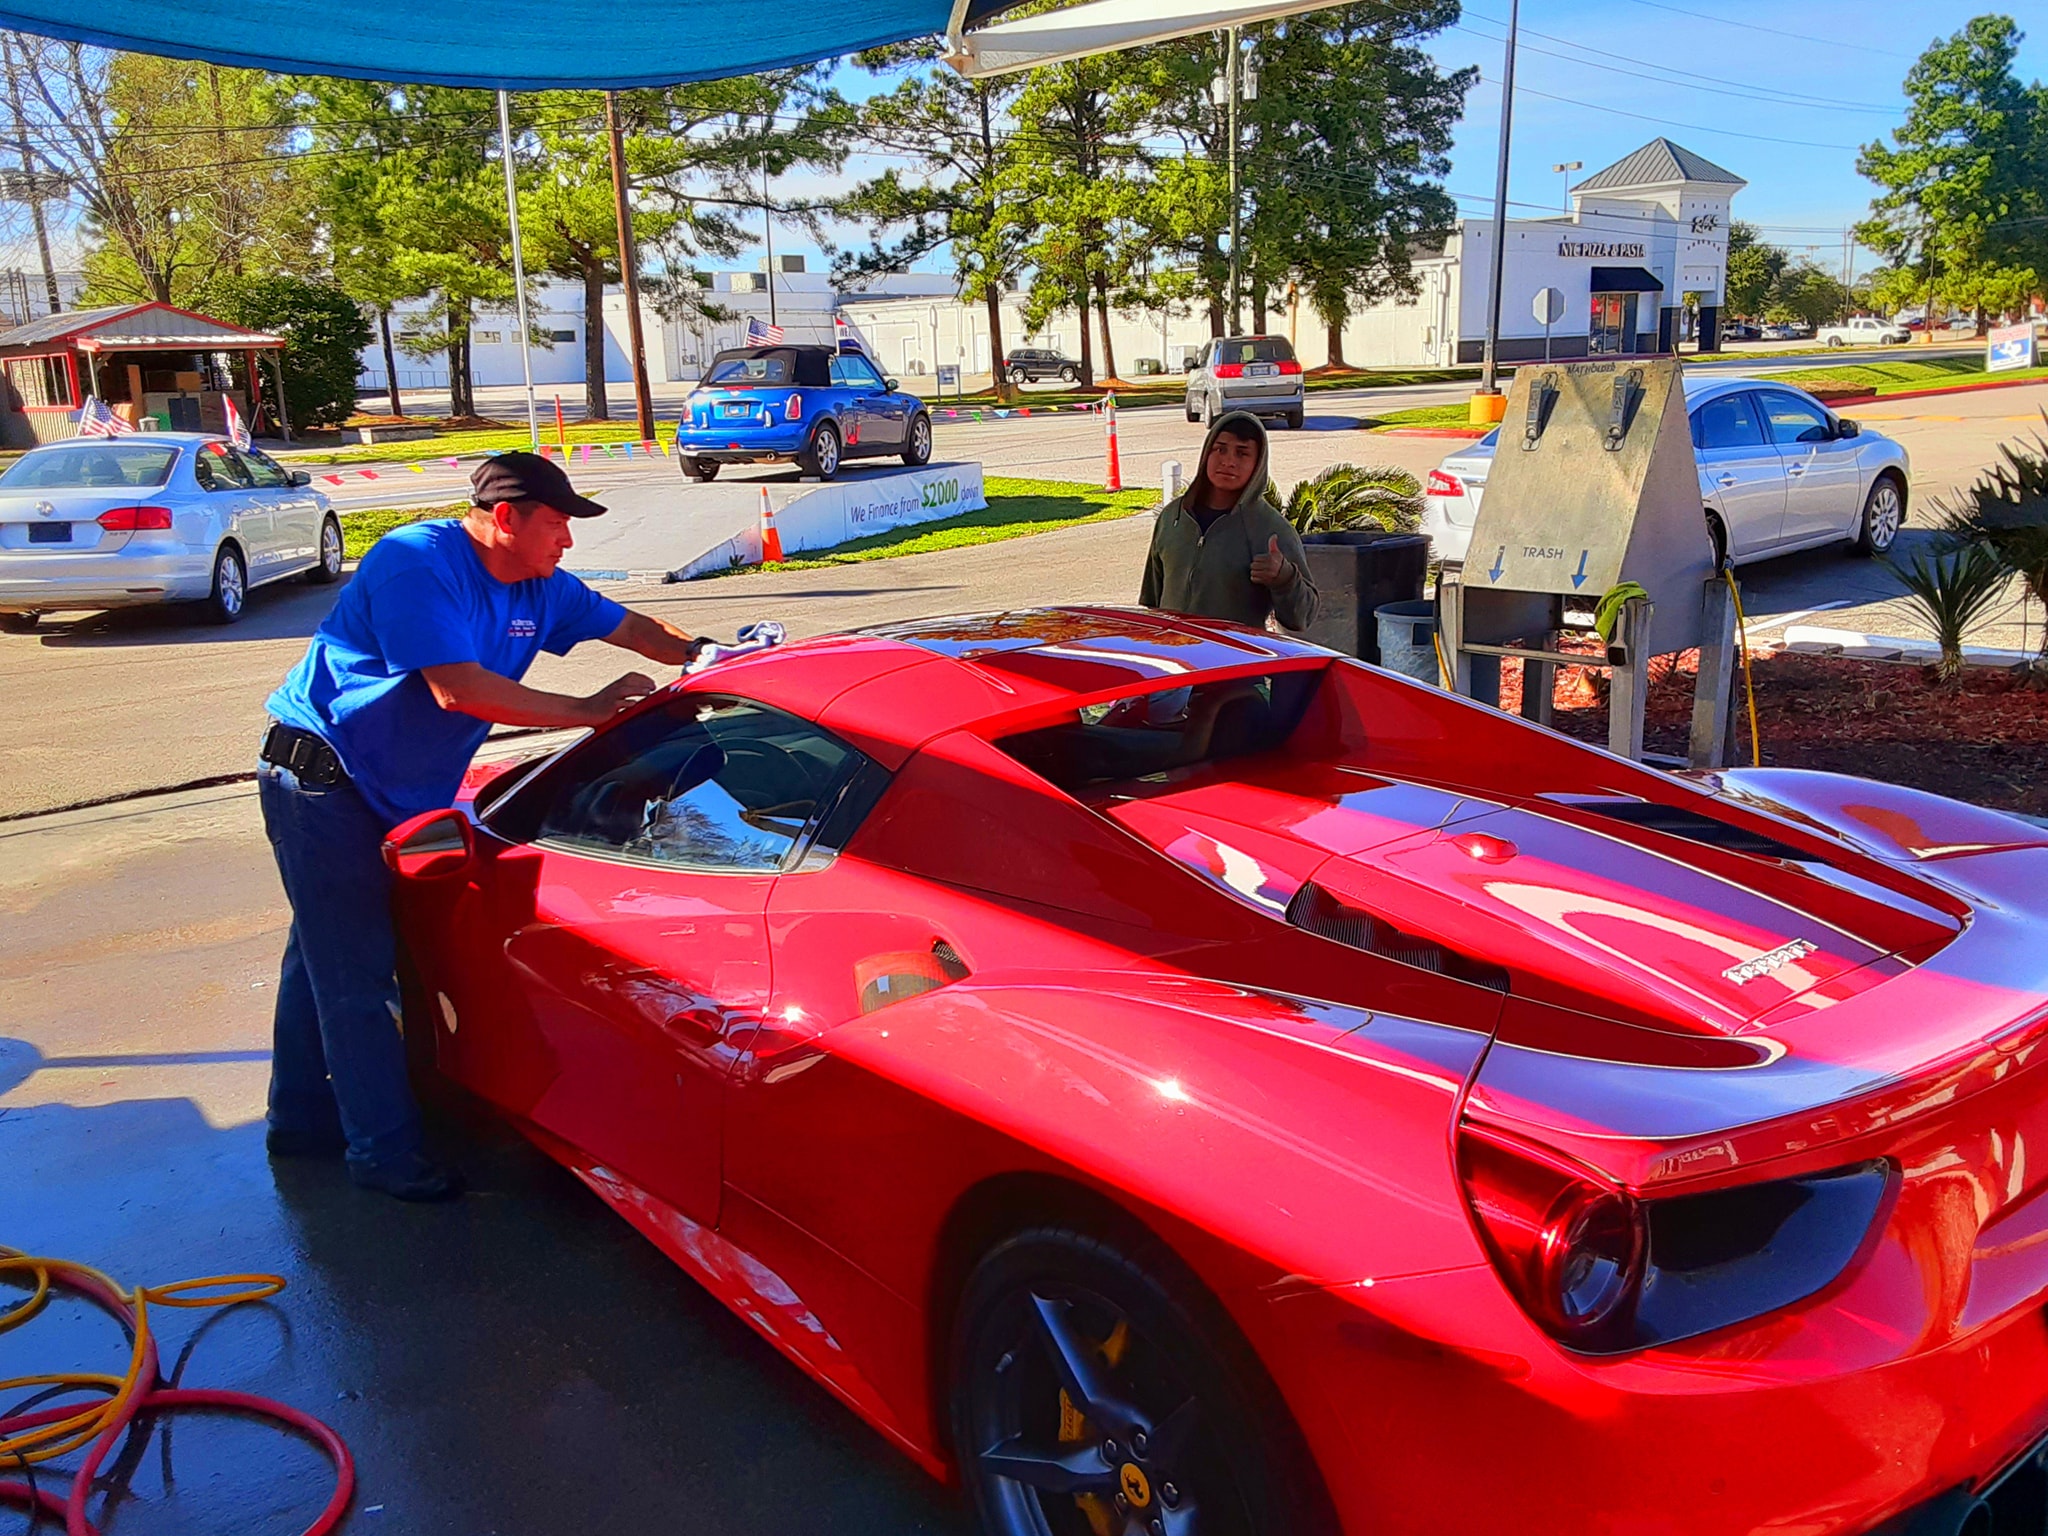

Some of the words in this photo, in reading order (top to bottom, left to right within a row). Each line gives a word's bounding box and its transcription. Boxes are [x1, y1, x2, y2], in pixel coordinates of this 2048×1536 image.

[1559, 243, 1581, 257] NYC
[1582, 243, 1608, 257] PIZZA
[1610, 244, 1618, 257] &
[1619, 244, 1646, 257] PASTA
[851, 506, 865, 523] We
[868, 501, 898, 520] Finance
[899, 497, 919, 518] from
[921, 478, 958, 510] $2000
[961, 485, 979, 500] down
[1523, 547, 1564, 559] TRASH
